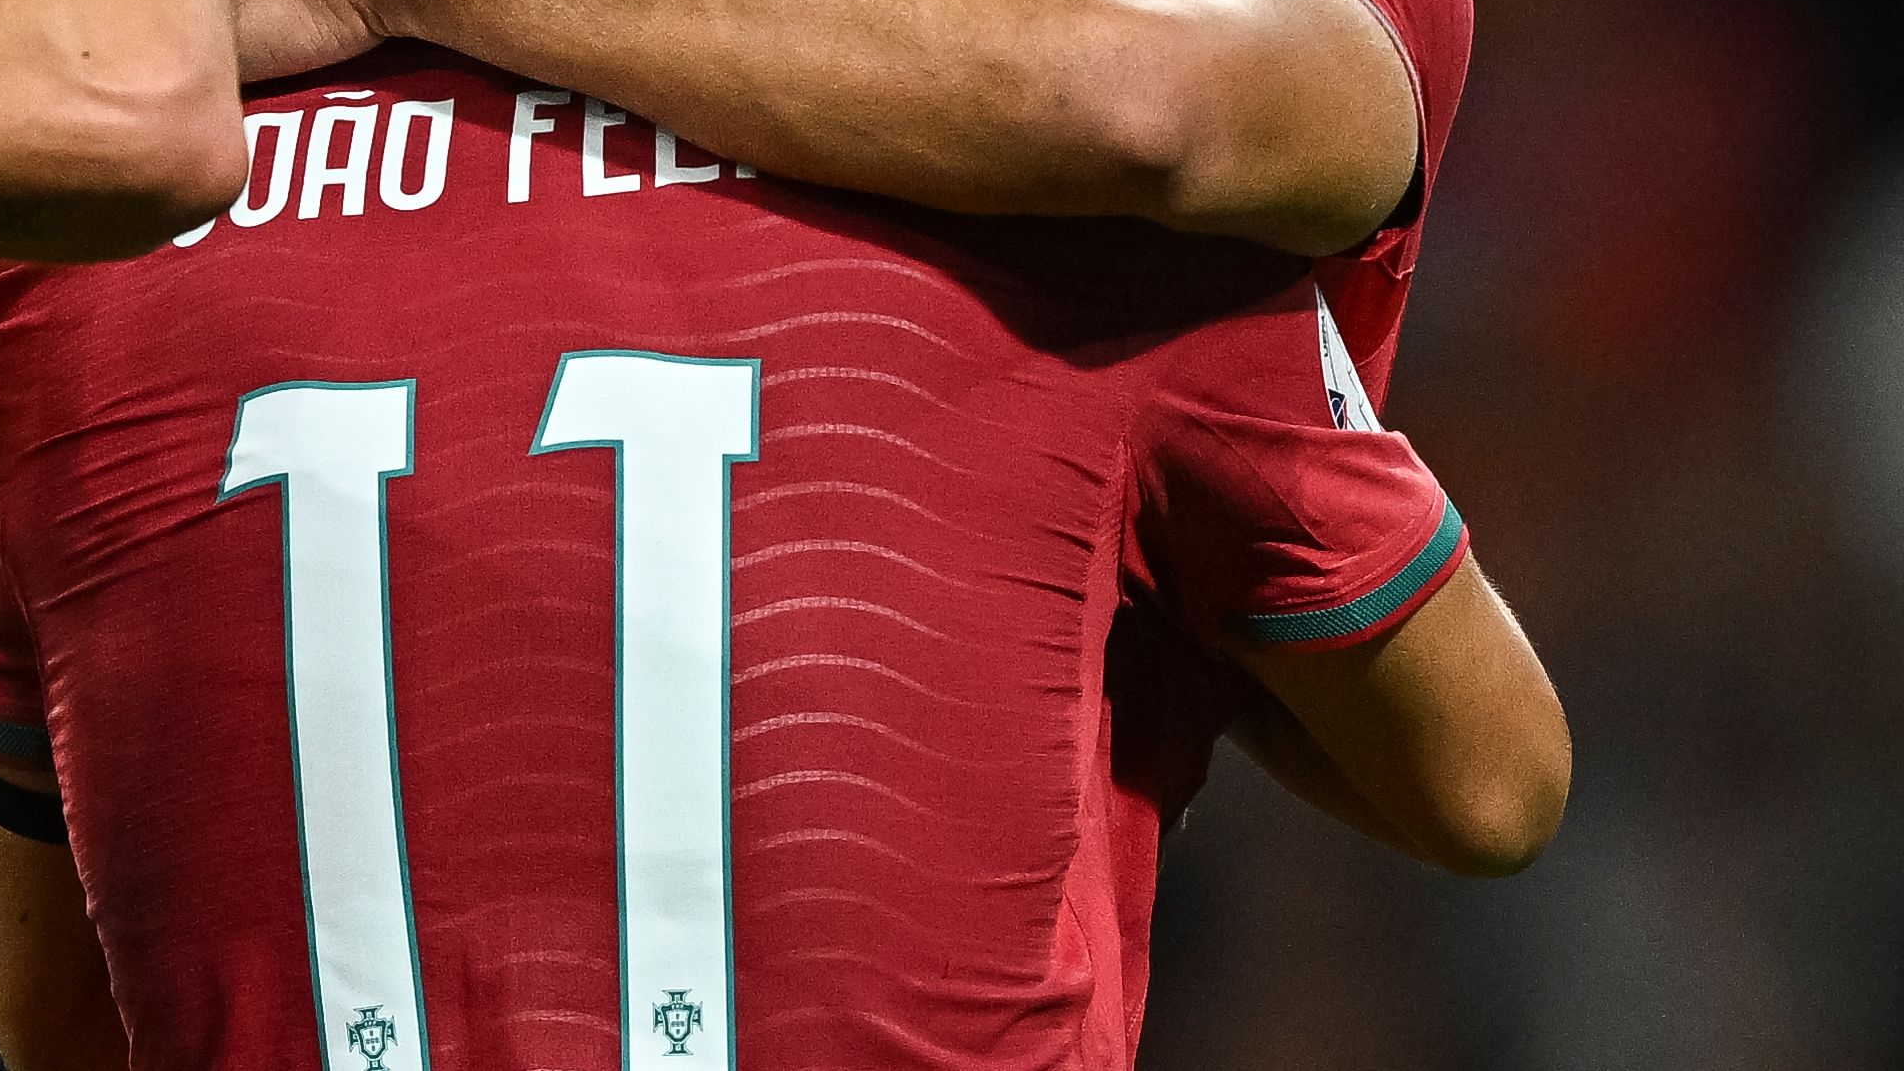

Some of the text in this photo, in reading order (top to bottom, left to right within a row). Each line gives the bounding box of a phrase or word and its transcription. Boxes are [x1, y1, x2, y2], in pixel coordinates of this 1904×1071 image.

[173, 90, 758, 248] OÃO FEL
[215, 350, 762, 1071] 11
